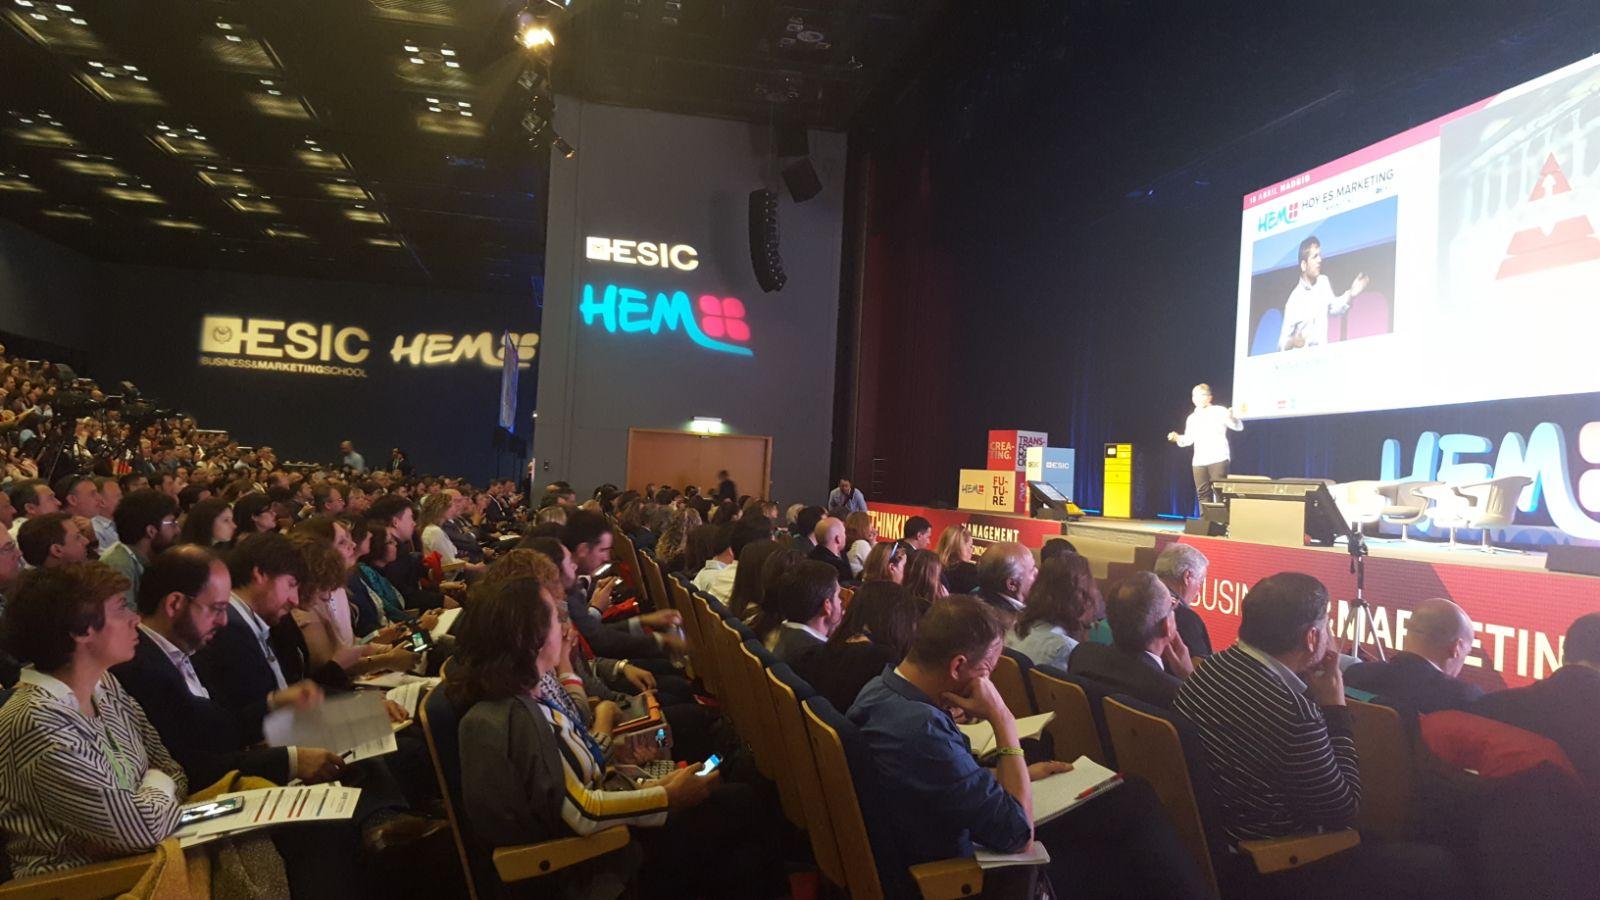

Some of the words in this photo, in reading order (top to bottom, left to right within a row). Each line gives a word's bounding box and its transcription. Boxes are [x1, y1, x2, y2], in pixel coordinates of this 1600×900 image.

[1280, 174, 1311, 192] MADRID
[1302, 196, 1320, 210] HOY
[1323, 190, 1334, 203] ES
[1336, 168, 1395, 198] MARKETING
[1257, 206, 1293, 232] HEM
[611, 239, 699, 272] ESIC
[579, 284, 733, 353] HEM
[246, 318, 370, 364] ESIC
[390, 331, 504, 367] HEM
[991, 441, 1015, 451] CREA-
[993, 475, 1008, 485] FU-
[993, 485, 1008, 495] TU-
[992, 495, 1007, 506] RE.
